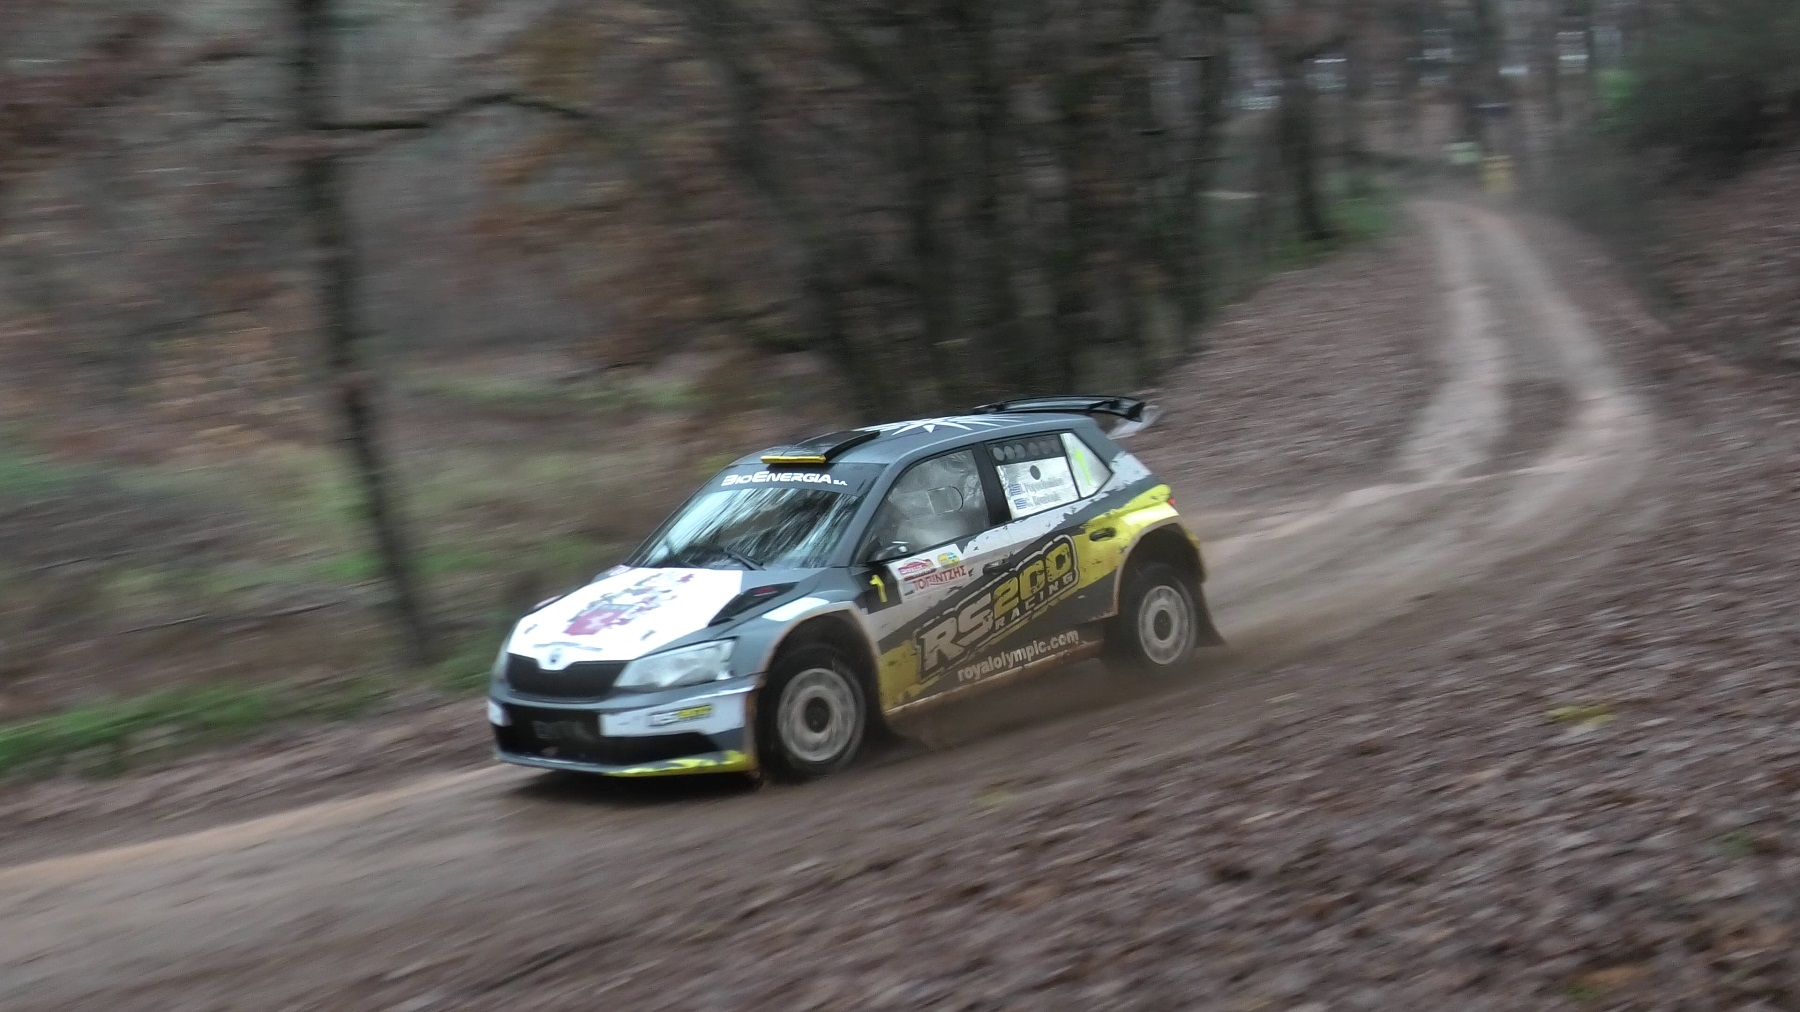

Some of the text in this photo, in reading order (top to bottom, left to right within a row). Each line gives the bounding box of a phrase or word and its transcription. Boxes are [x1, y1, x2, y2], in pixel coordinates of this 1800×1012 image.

[869, 574, 888, 603] 1
[994, 572, 1074, 630] RACING
[957, 629, 1079, 682] royalolympic.com
